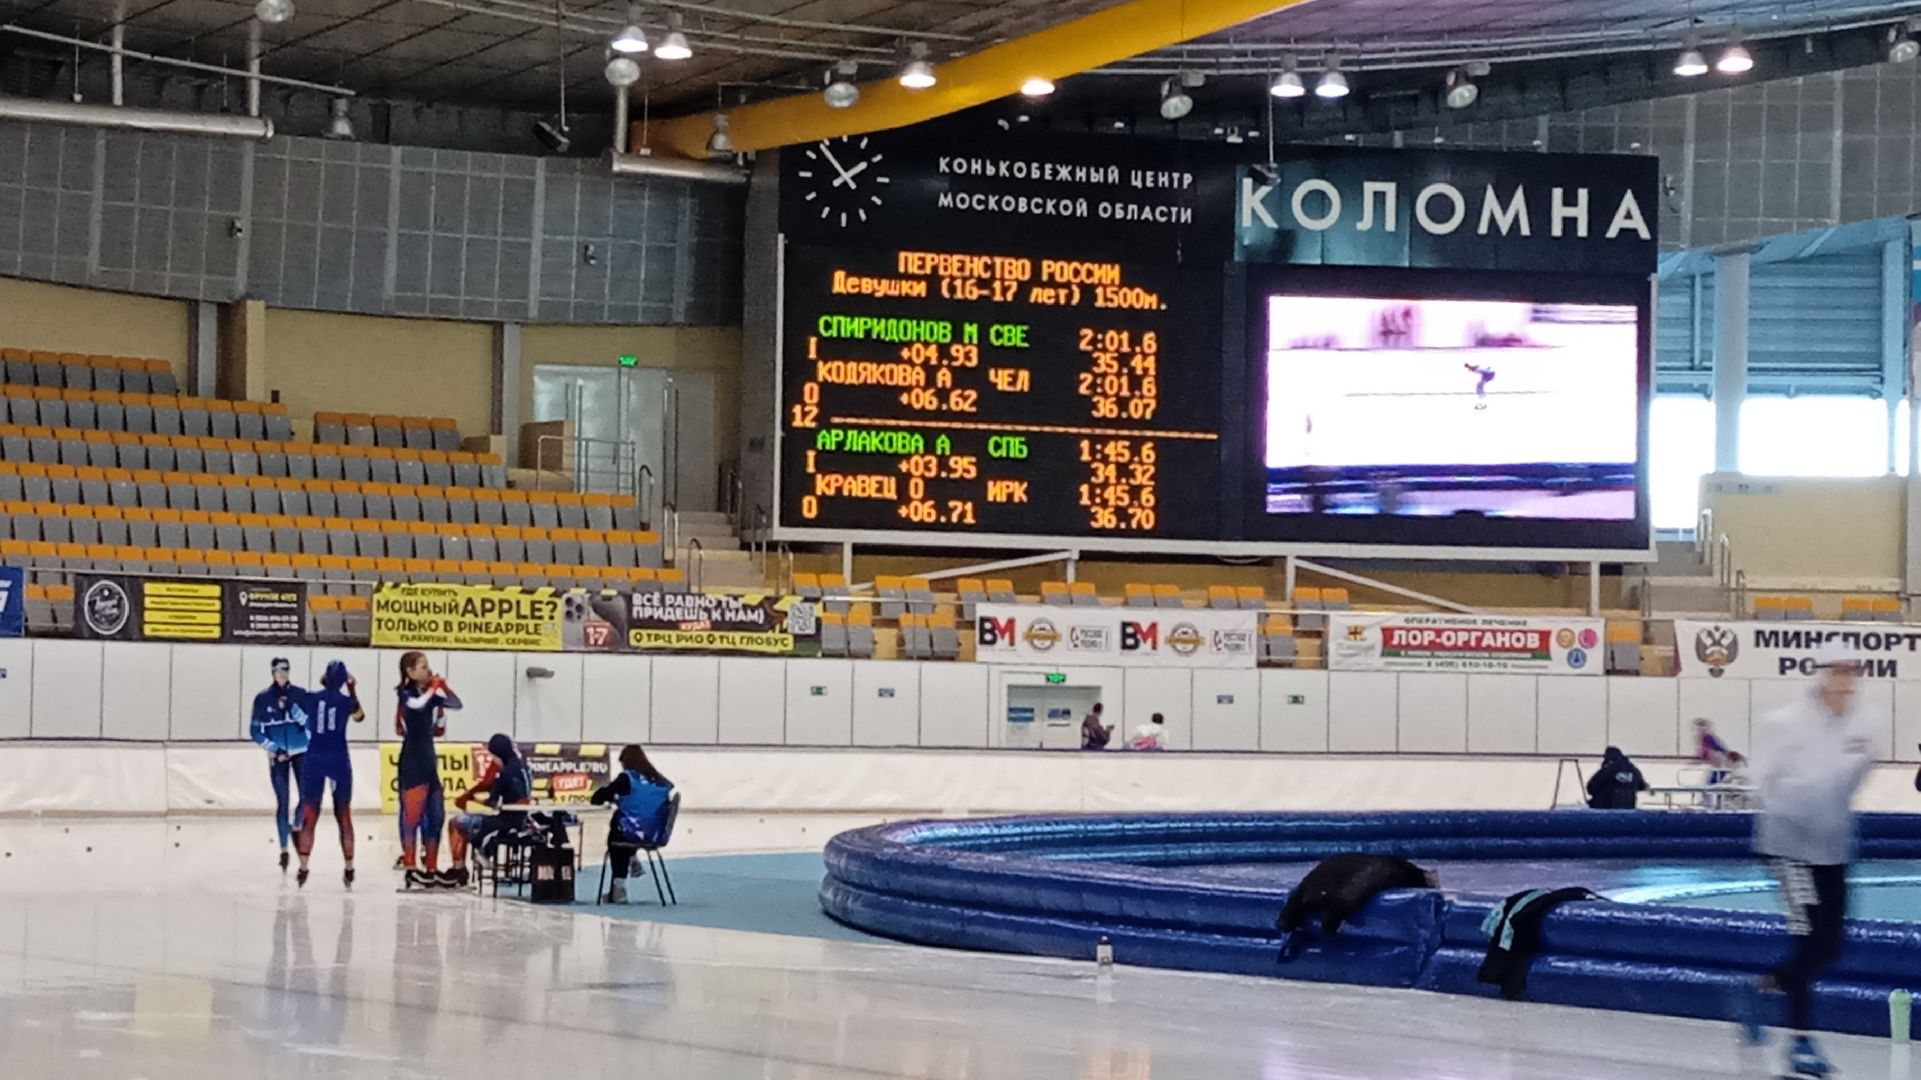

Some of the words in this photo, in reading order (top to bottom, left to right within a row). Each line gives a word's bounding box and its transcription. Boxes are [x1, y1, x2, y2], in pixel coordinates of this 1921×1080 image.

[938, 156, 1119, 185] КОНЬКОБЕЖНЫЙ
[1130, 167, 1194, 196] ЦЕНТР
[938, 190, 1088, 219] МОСКОВСКОЙ
[1099, 202, 1193, 225] ОБЛАСТИ
[1241, 177, 1652, 241] КОЛОМНА
[899, 251, 1031, 281] ПЕРВЕНСТВО
[1041, 260, 1121, 286] РОССИИ
[832, 270, 927, 298] Девушки
[941, 279, 1018, 302] (16-17
[1030, 285, 1081, 307] лет)
[1095, 286, 1167, 312] 1500м.
[819, 315, 952, 343] СПИРИДОНОВ
[963, 323, 979, 346] М
[990, 325, 1029, 349] СВЕ
[1079, 330, 1157, 354] 2:01.6
[900, 342, 979, 367] +04.93
[1092, 353, 1156, 377] 35.44
[817, 360, 926, 388] КОДЯКОВА
[937, 368, 952, 390] А
[989, 368, 1030, 393] ЧЕЛ
[1079, 374, 1157, 398] 2:01.6
[791, 404, 819, 428] 12
[899, 388, 978, 413] +06.62
[1092, 397, 1156, 421] 36.07
[816, 429, 924, 455] АРЛАКОВА
[936, 434, 951, 456] А
[988, 436, 1029, 459] СПБ
[1080, 441, 1156, 464] 1:45.6
[898, 454, 978, 479] +03.95
[1091, 463, 1156, 486] 34.32
[815, 473, 898, 501] КРАВЕЦ
[987, 480, 1028, 504] ИРК
[1079, 484, 1156, 508] 1:45.6
[898, 500, 976, 525] +06.71
[1091, 507, 1156, 531] 36.70
[376, 600, 459, 616] МОЩНЫЙ
[460, 597, 558, 621] APPLE?
[665, 595, 717, 609] РАВНО
[721, 597, 742, 609] ТЫ
[712, 609, 721, 621] К
[375, 618, 438, 632] ТОЛЬКО
[460, 621, 542, 636] PINEAPPLE
[586, 626, 609, 646] 17
[646, 634, 672, 644] ТРЦ
[676, 635, 704, 645] РИО
[717, 635, 735, 647] ТЦ
[739, 635, 790, 648] ГЛОБУС
[1391, 629, 1541, 650] ЛОР-ОРГАНОВ
